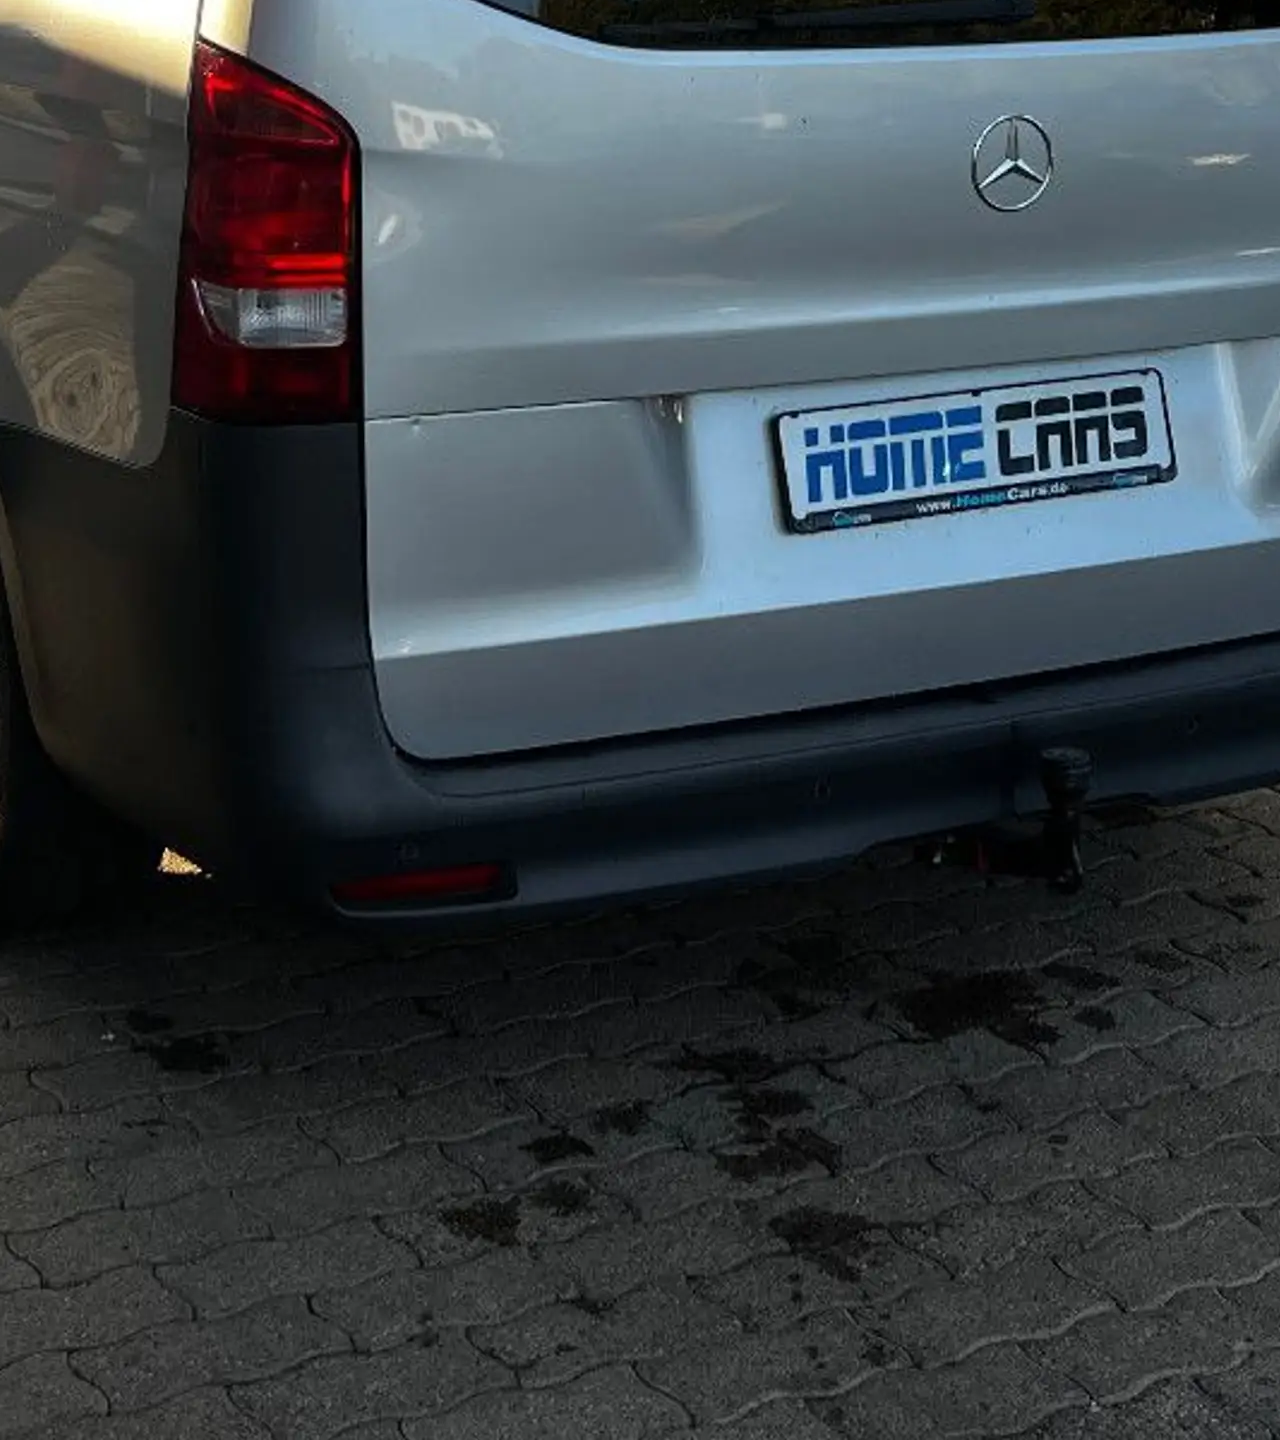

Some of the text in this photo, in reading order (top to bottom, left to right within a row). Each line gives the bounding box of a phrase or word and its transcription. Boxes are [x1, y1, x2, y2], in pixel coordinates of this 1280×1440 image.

[804, 386, 1148, 503] HOME CARS
[916, 482, 1068, 513] www.HomeCars.de
